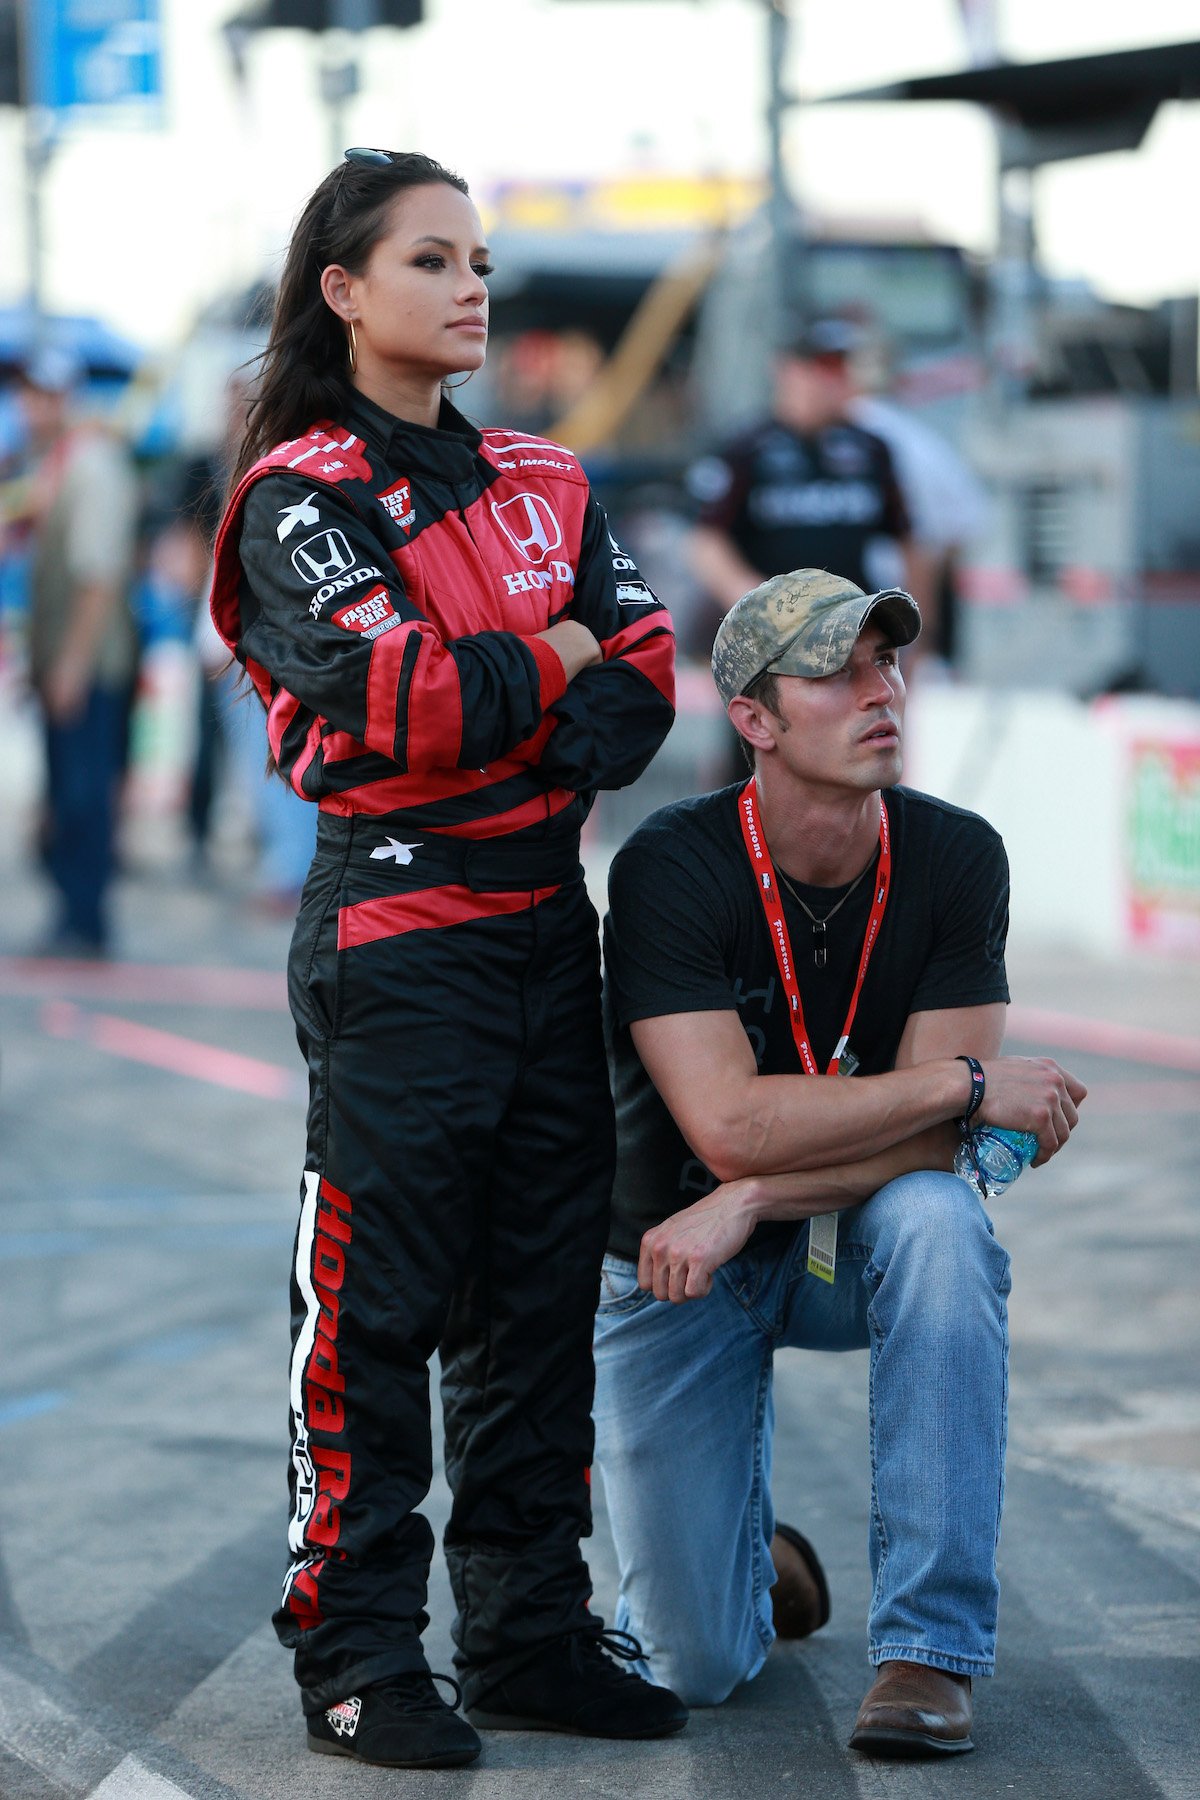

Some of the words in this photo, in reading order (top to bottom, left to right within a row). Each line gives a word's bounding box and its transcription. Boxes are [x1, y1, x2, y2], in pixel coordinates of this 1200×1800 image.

[520, 459, 575, 471] IMPACT
[377, 486, 409, 507] TEST
[502, 561, 575, 596] HOND
[340, 591, 389, 628] FASTEST
[358, 607, 388, 629] SEAT
[742, 797, 763, 859] Firestone
[773, 918, 791, 981] Firestone
[800, 1041, 816, 1076] Fires
[305, 1176, 353, 1436] Honda
